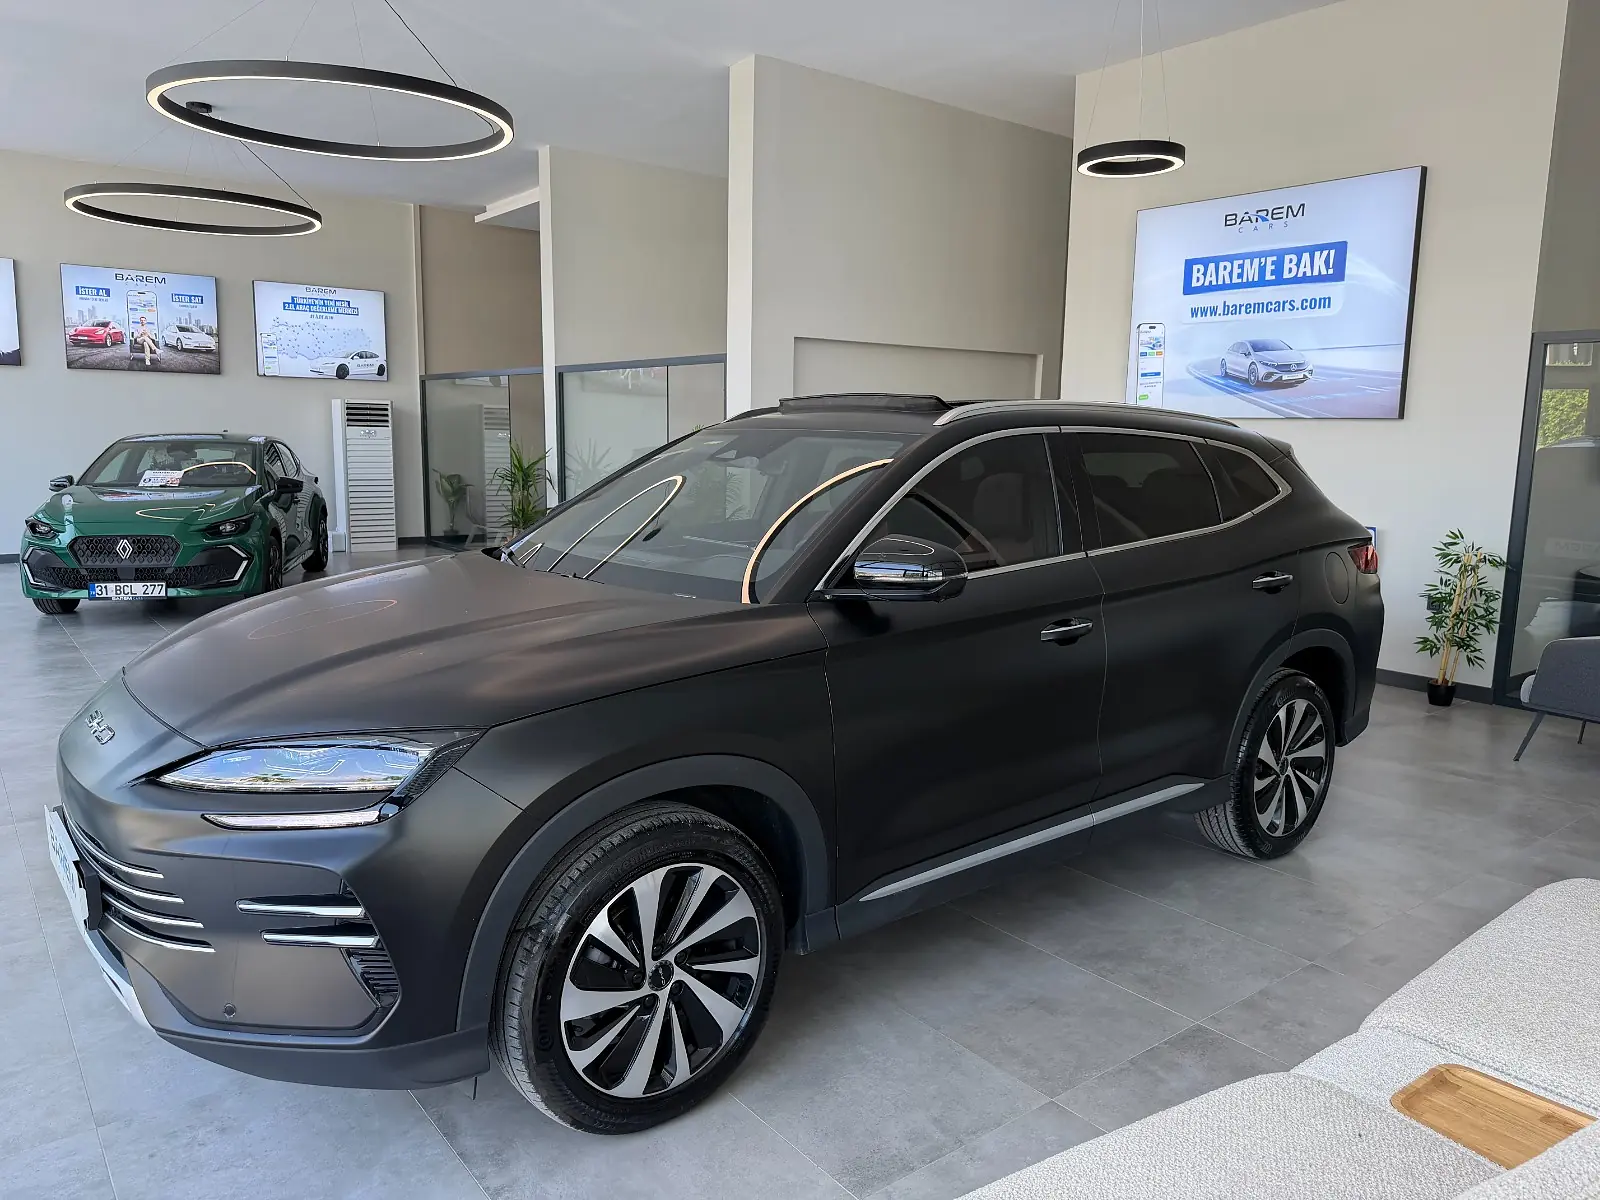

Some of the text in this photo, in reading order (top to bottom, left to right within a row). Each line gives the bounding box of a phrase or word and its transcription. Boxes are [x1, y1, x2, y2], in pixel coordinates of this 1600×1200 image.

[1224, 203, 1306, 227] BAREM
[1238, 220, 1289, 234] CARS
[1191, 249, 1336, 288] BAREM'E BAK!
[114, 273, 167, 285] BAREM
[79, 286, 108, 297] İSTER AL
[305, 287, 337, 295] BAREM
[172, 293, 202, 304] İSTER SAT
[1190, 296, 1332, 318] www.baremcars.com
[96, 584, 109, 596] 31
[114, 584, 138, 596] BCL
[142, 583, 164, 596] 277
